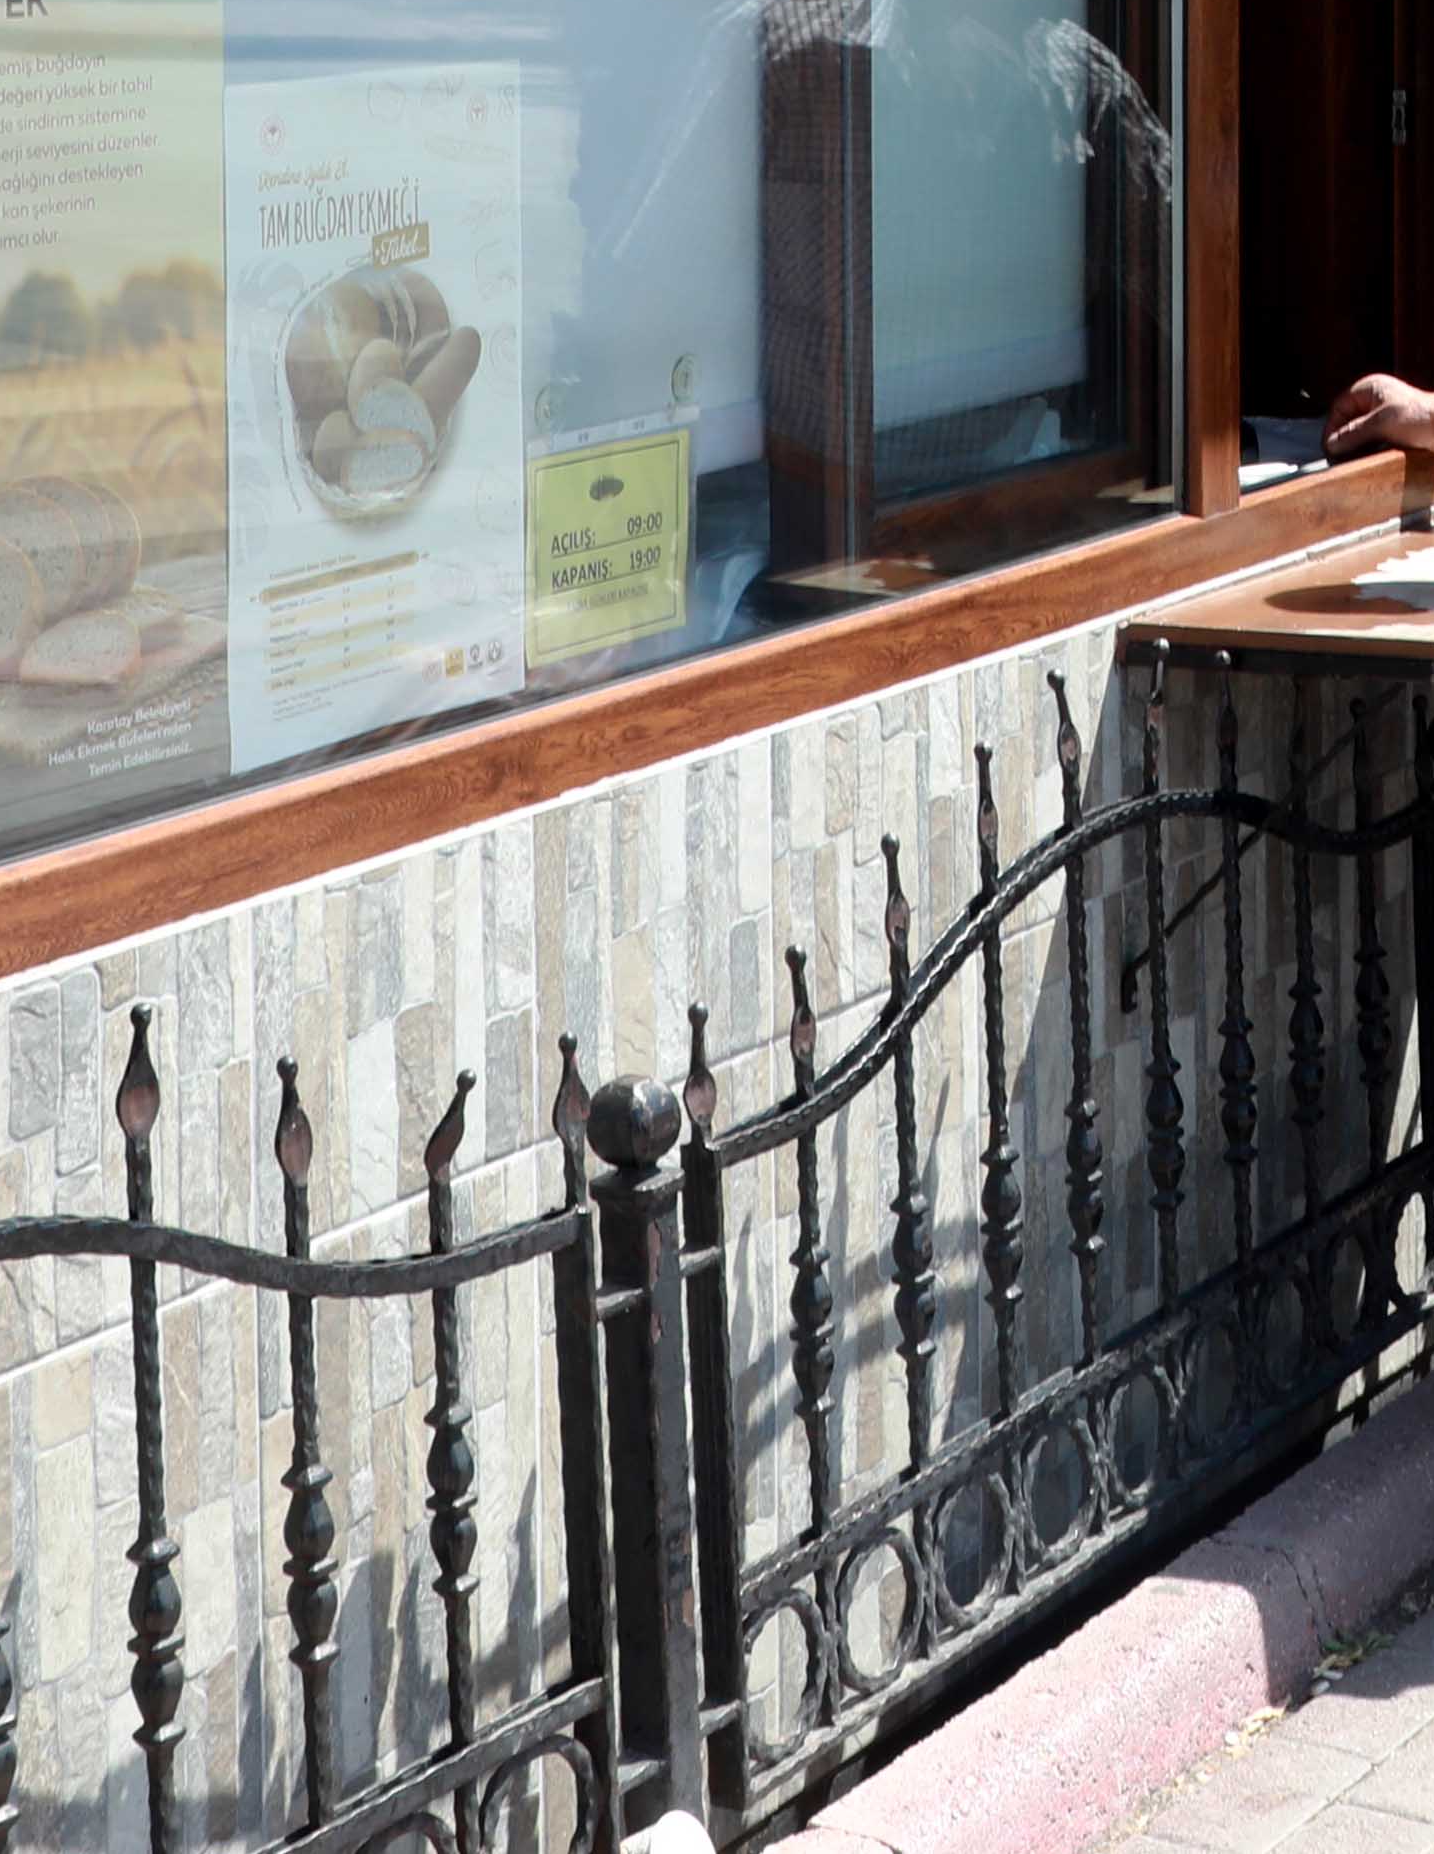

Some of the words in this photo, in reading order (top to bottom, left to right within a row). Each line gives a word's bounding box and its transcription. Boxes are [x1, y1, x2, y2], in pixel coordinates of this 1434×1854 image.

[1, 206, 30, 220] kan
[259, 201, 292, 251] TAM
[294, 186, 356, 244] BUĞDAY
[358, 174, 422, 236] EKMEĞİ
[551, 526, 597, 557] AÇILIŞ:
[626, 511, 664, 536] 09:00
[551, 557, 614, 590] KAPANIŞ:
[628, 545, 663, 571] 19:00
